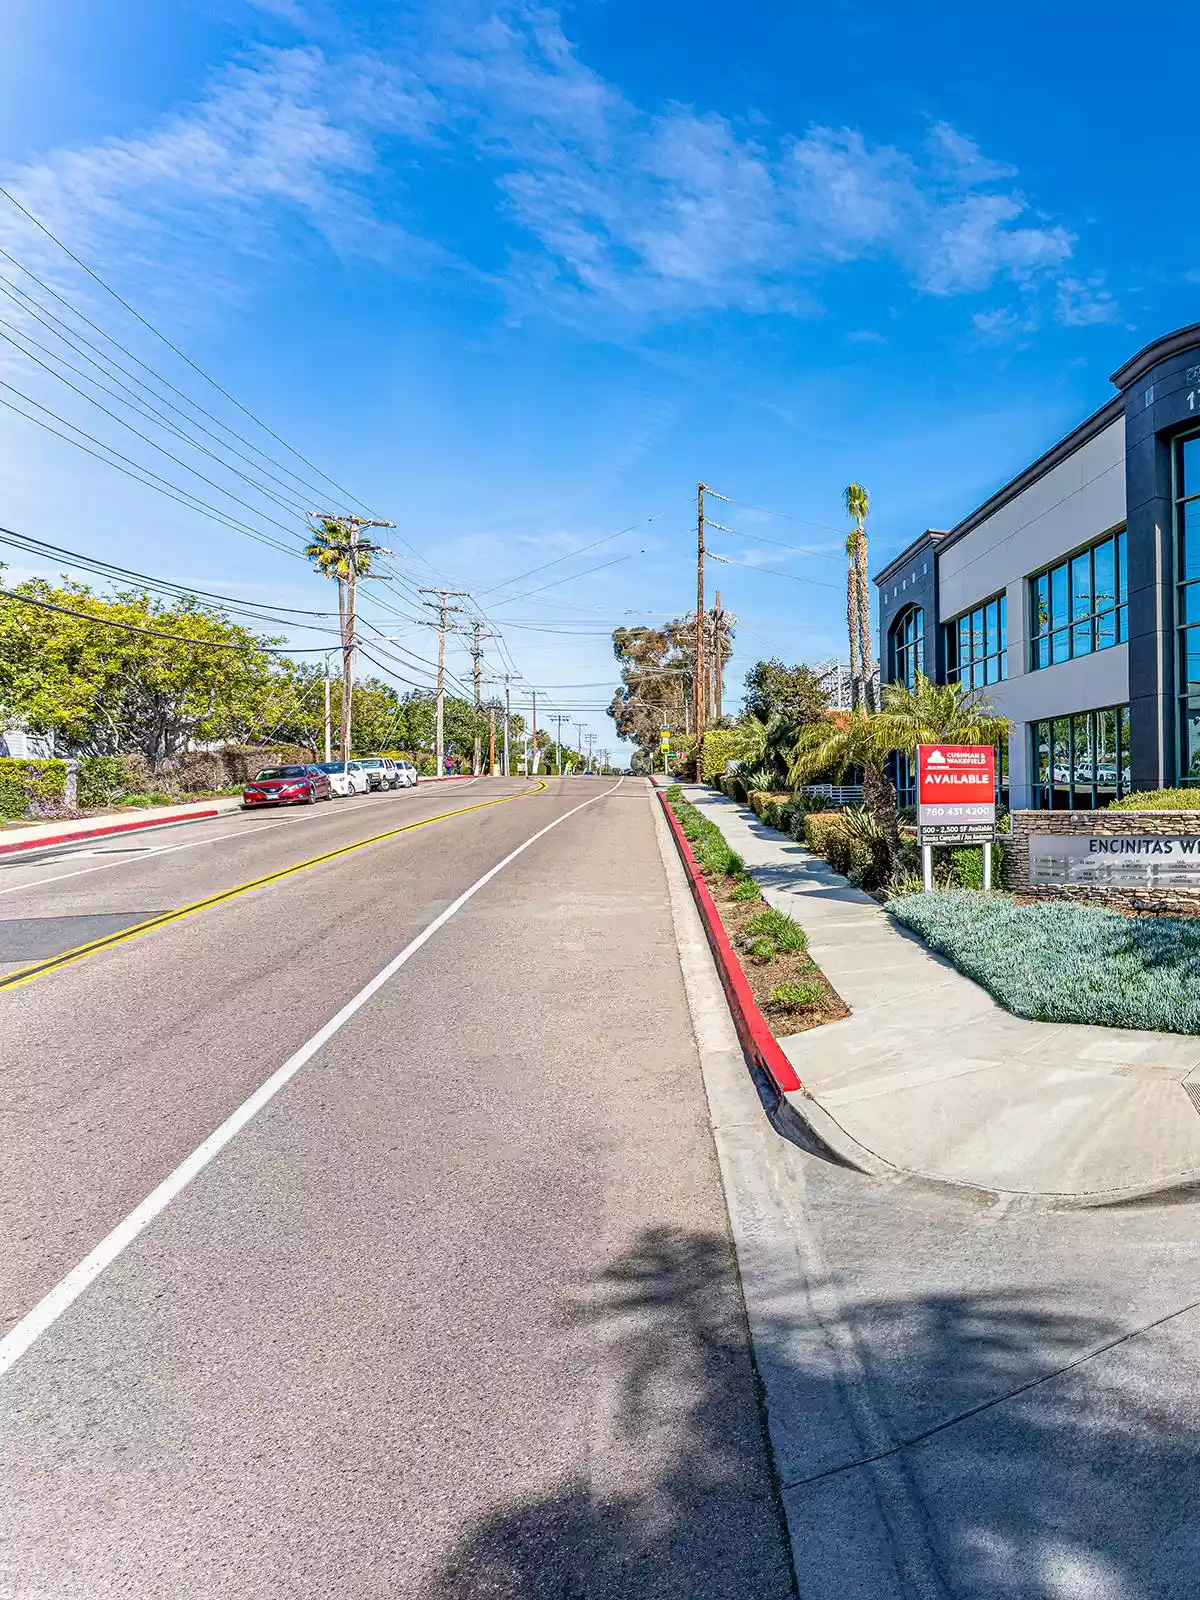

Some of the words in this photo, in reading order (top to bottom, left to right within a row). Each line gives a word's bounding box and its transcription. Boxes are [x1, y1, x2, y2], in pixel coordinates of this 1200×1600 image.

[924, 774, 990, 784] AVAILABLE
[922, 826, 935, 834] 500
[940, 826, 959, 834] 2,500
[959, 825, 968, 833] SF
[1089, 839, 1173, 855] ENCINITAS
